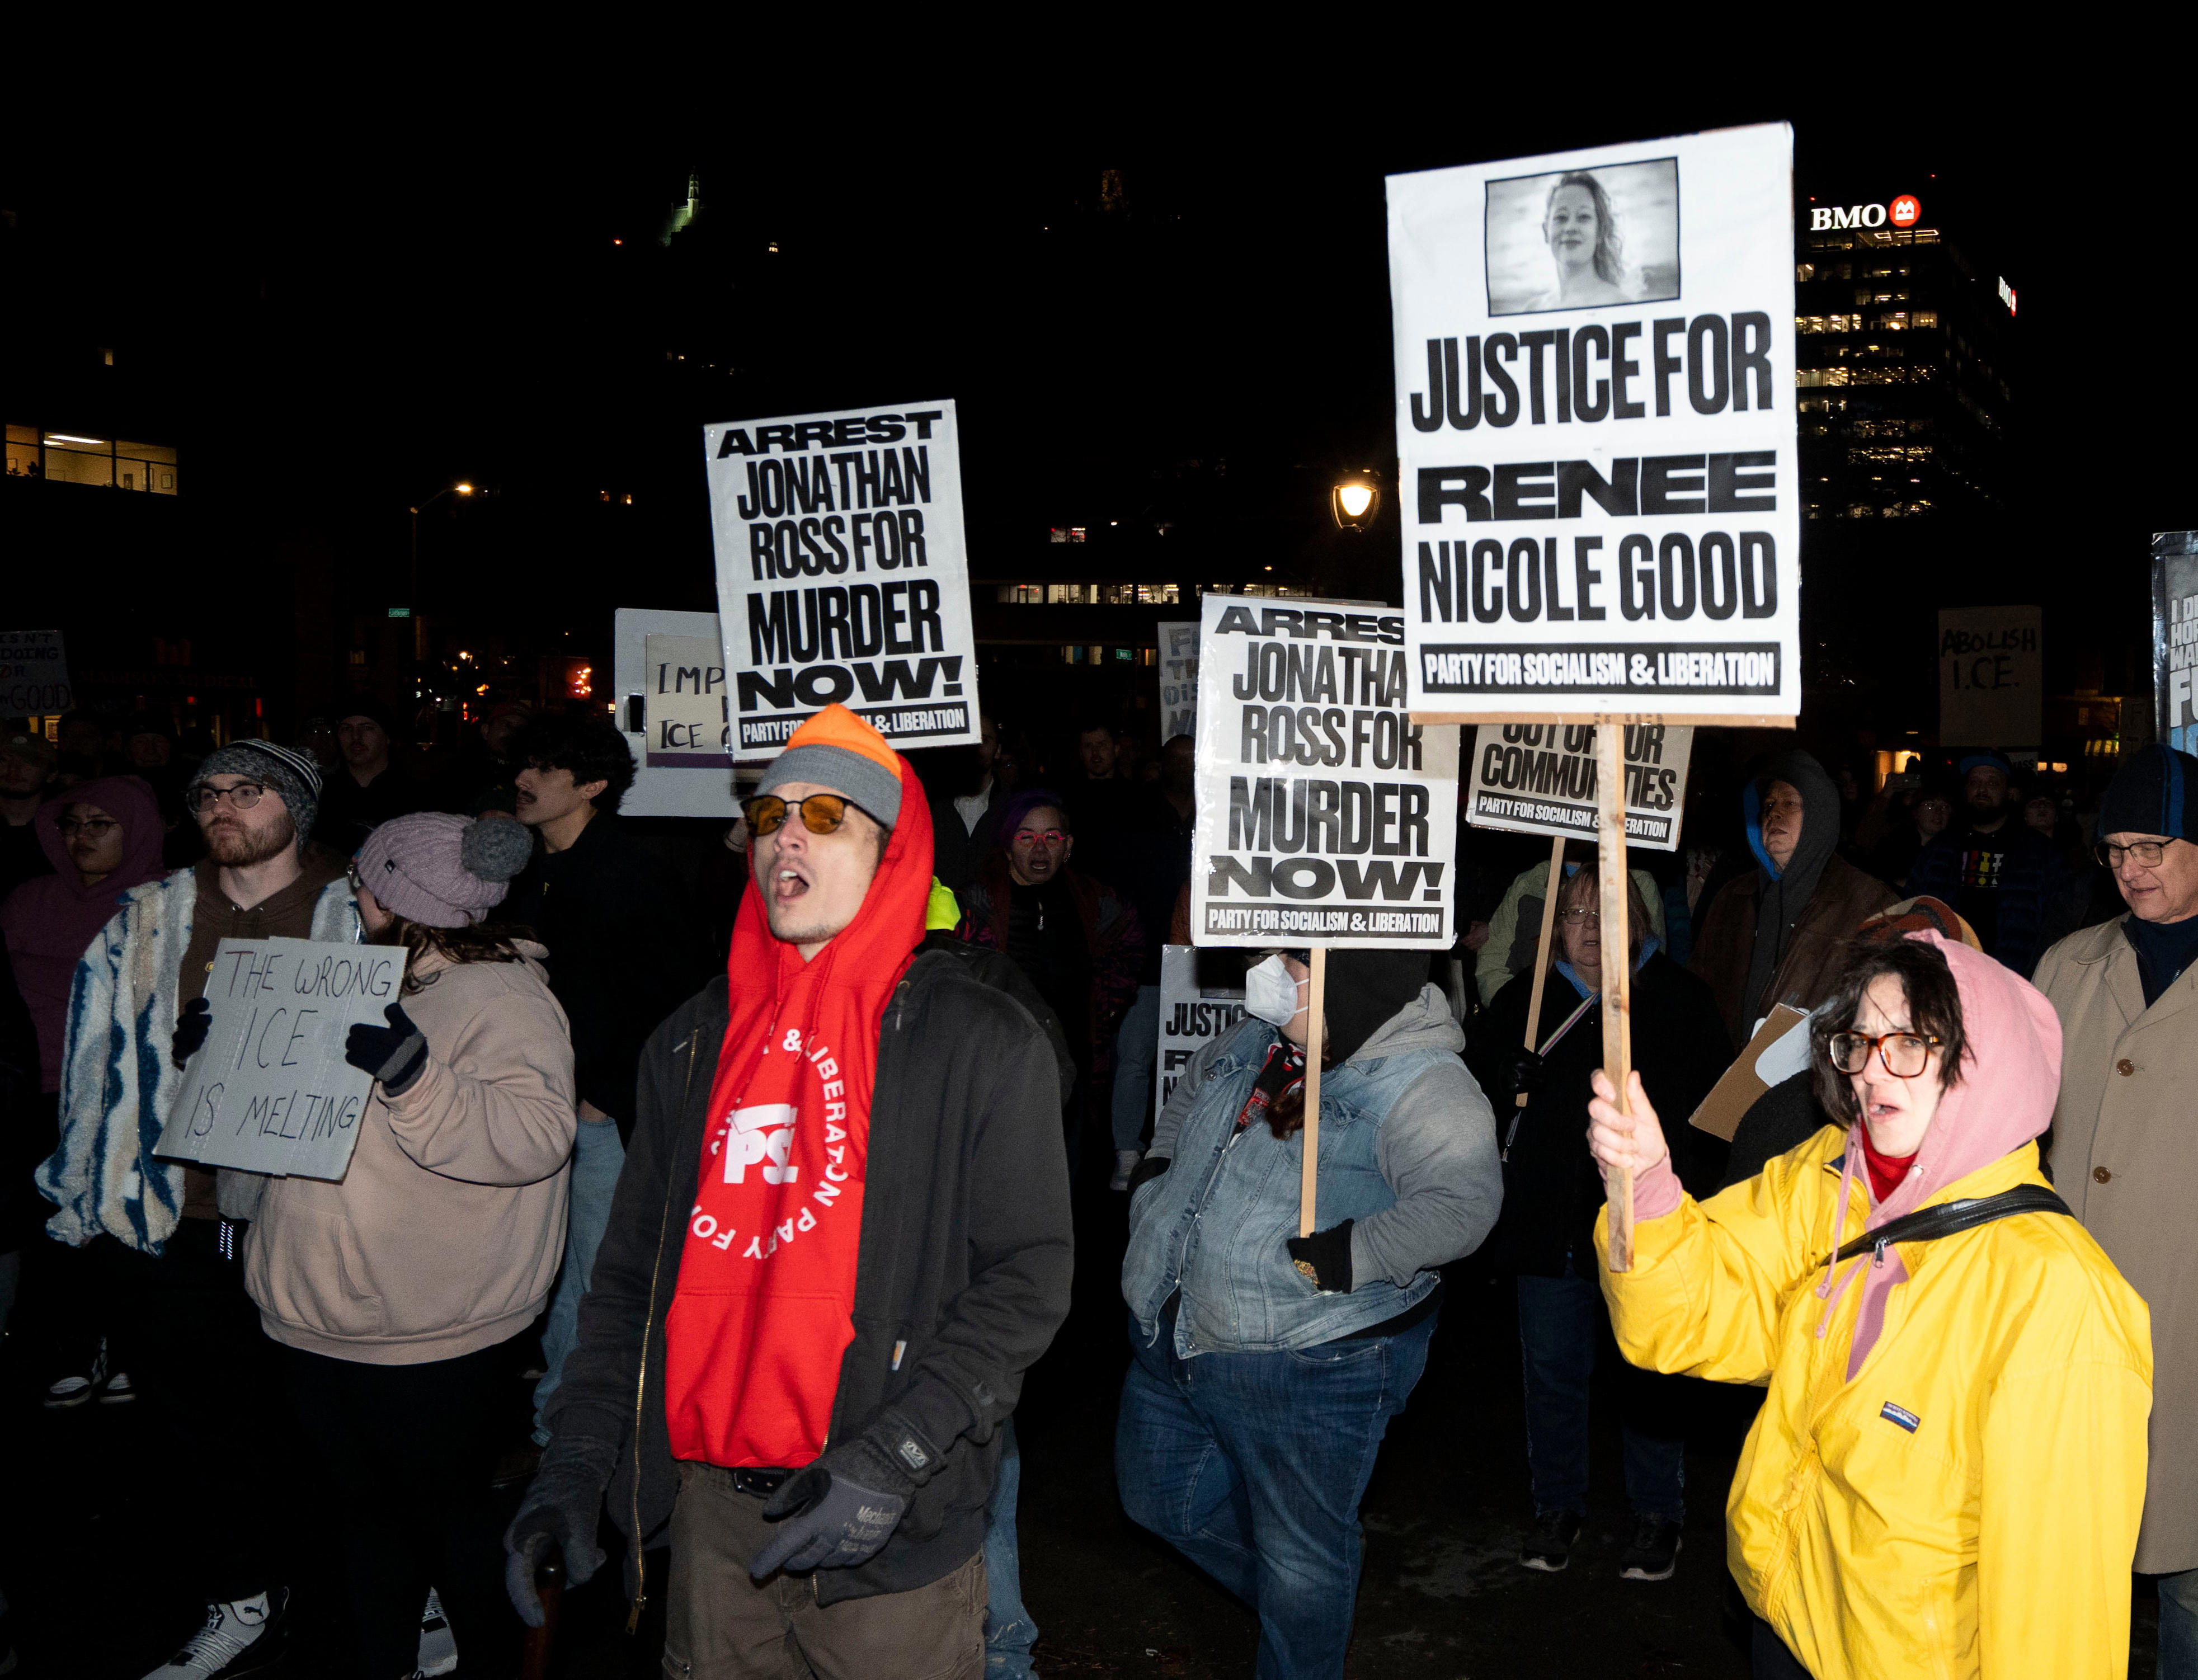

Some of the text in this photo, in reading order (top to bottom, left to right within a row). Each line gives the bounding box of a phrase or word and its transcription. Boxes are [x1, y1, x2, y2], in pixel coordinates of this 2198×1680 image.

[1810, 204, 1886, 231] BMO
[1410, 311, 1773, 432] JUSTICE FOR
[717, 411, 942, 458] ARREST
[737, 445, 931, 520] JONATHAN
[1418, 450, 1776, 524] RENEE
[750, 509, 928, 581] ROSS FOR
[1418, 531, 1777, 623] NICOLE GOOD
[747, 579, 944, 666] MURDER
[1215, 606, 1405, 645] ARRES
[1941, 628, 2036, 657] ABOLISH
[657, 663, 726, 695] IMP
[736, 655, 963, 712] NOW!
[1232, 642, 1407, 708] JONATHA
[1424, 652, 1774, 686] PARTY FOR SOCIALISM & LIBERATION
[11, 684, 70, 710] GOOD
[658, 719, 703, 749] ICE
[742, 721, 780, 743] PARTY
[874, 714, 891, 733] &
[892, 708, 964, 733] LIBERATION
[1241, 704, 1346, 767] ROSS
[1352, 710, 1423, 770] FOR
[1623, 724, 1665, 764] UR
[1481, 743, 1677, 811] COMMUNIES
[1228, 776, 1429, 857] MURDER
[1479, 797, 1513, 816] PARTY
[1513, 802, 1533, 819] FOR
[1535, 804, 1592, 827] SOCIALISM
[1626, 817, 1667, 838] ERATION
[1208, 856, 1445, 901] NOW!
[1209, 909, 1439, 933] PARTY FOR SOCIALISM & LIBERATION
[225, 951, 391, 999] THE WRONG
[237, 1008, 318, 1070] ICE
[1166, 1003, 1248, 1036] JUSTI
[185, 1083, 358, 1141] IS MELTING
[691, 1205, 736, 1250] FO
[783, 1028, 802, 1052] &
